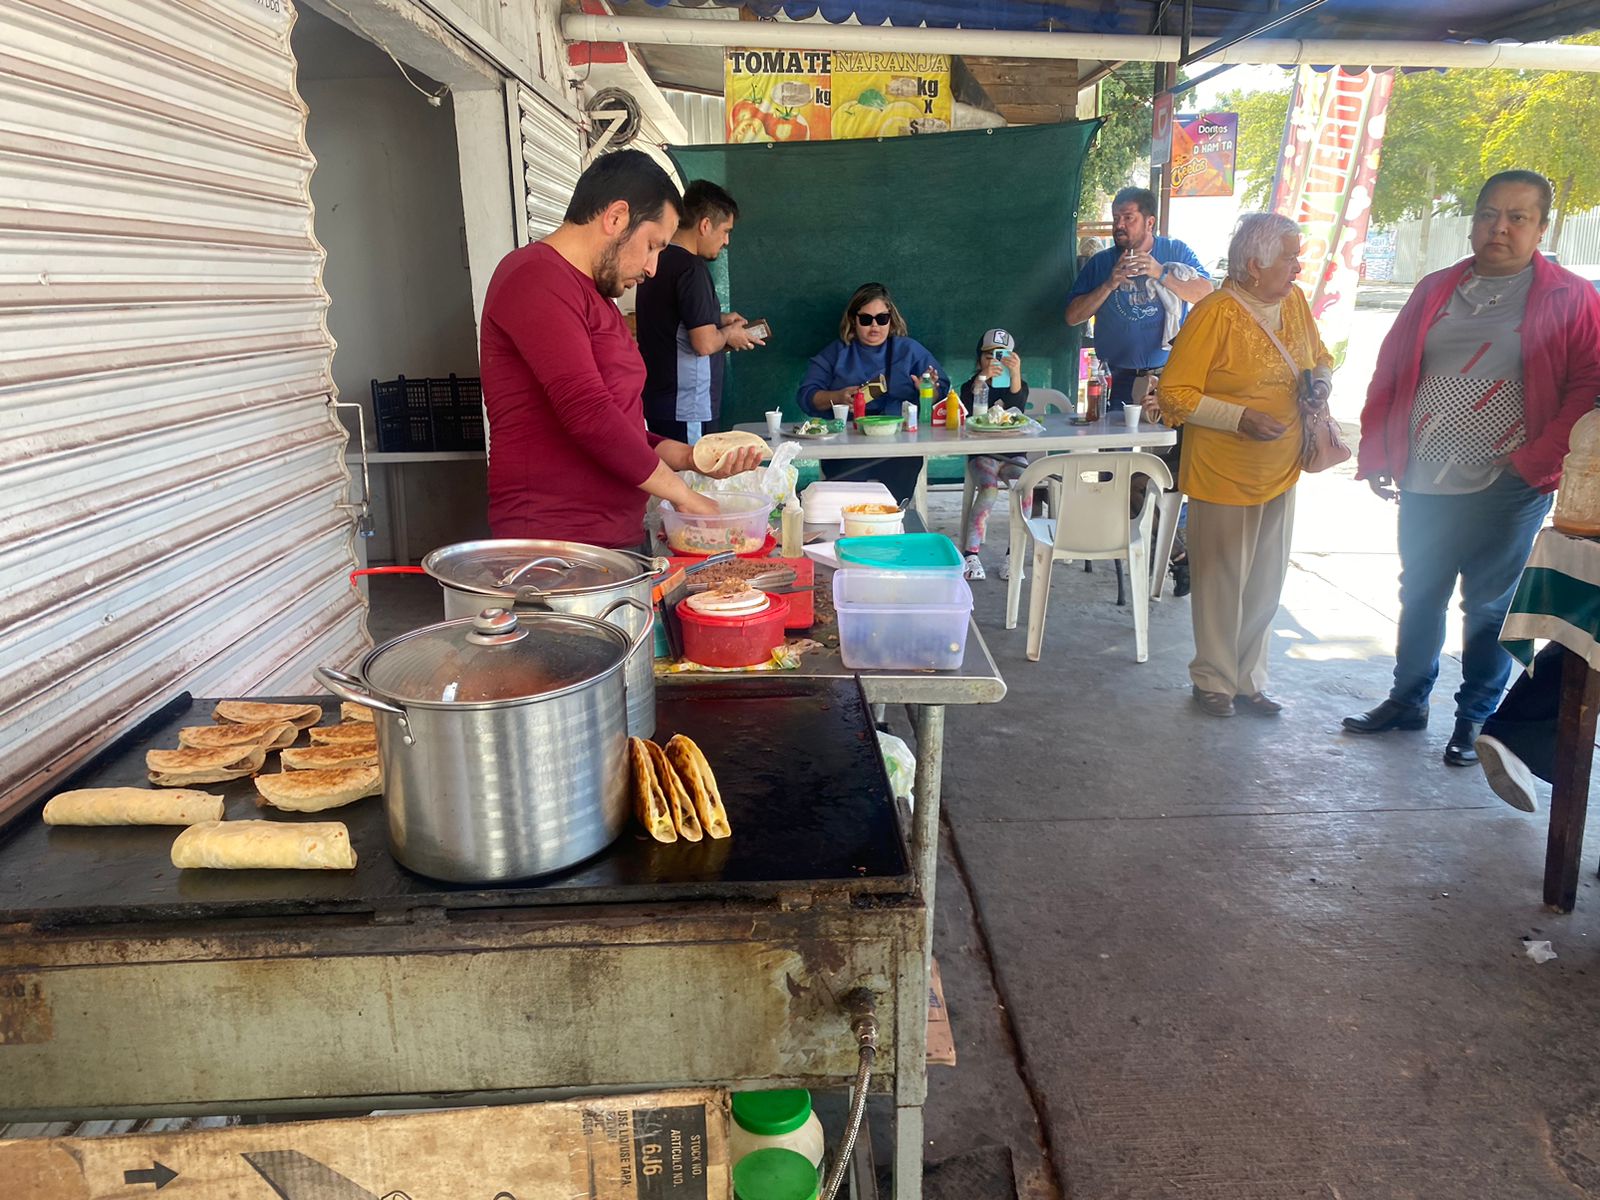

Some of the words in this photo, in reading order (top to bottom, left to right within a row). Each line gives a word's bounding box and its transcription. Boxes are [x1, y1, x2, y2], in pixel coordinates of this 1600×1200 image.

[834, 51, 950, 73] NARANJA
[815, 87, 831, 106] kg
[916, 77, 939, 98] kg
[1198, 125, 1229, 134] Doritos
[1170, 158, 1208, 188] Cheetos
[1298, 202, 1336, 225] Y
[617, 1110, 629, 1128] USE
[670, 1129, 683, 1171] ARTÍCULO
[690, 1134, 701, 1161] STOCK
[641, 1143, 663, 1176] 6J6
[692, 1162, 703, 1178] NO.
[673, 1172, 684, 1188] NO.
